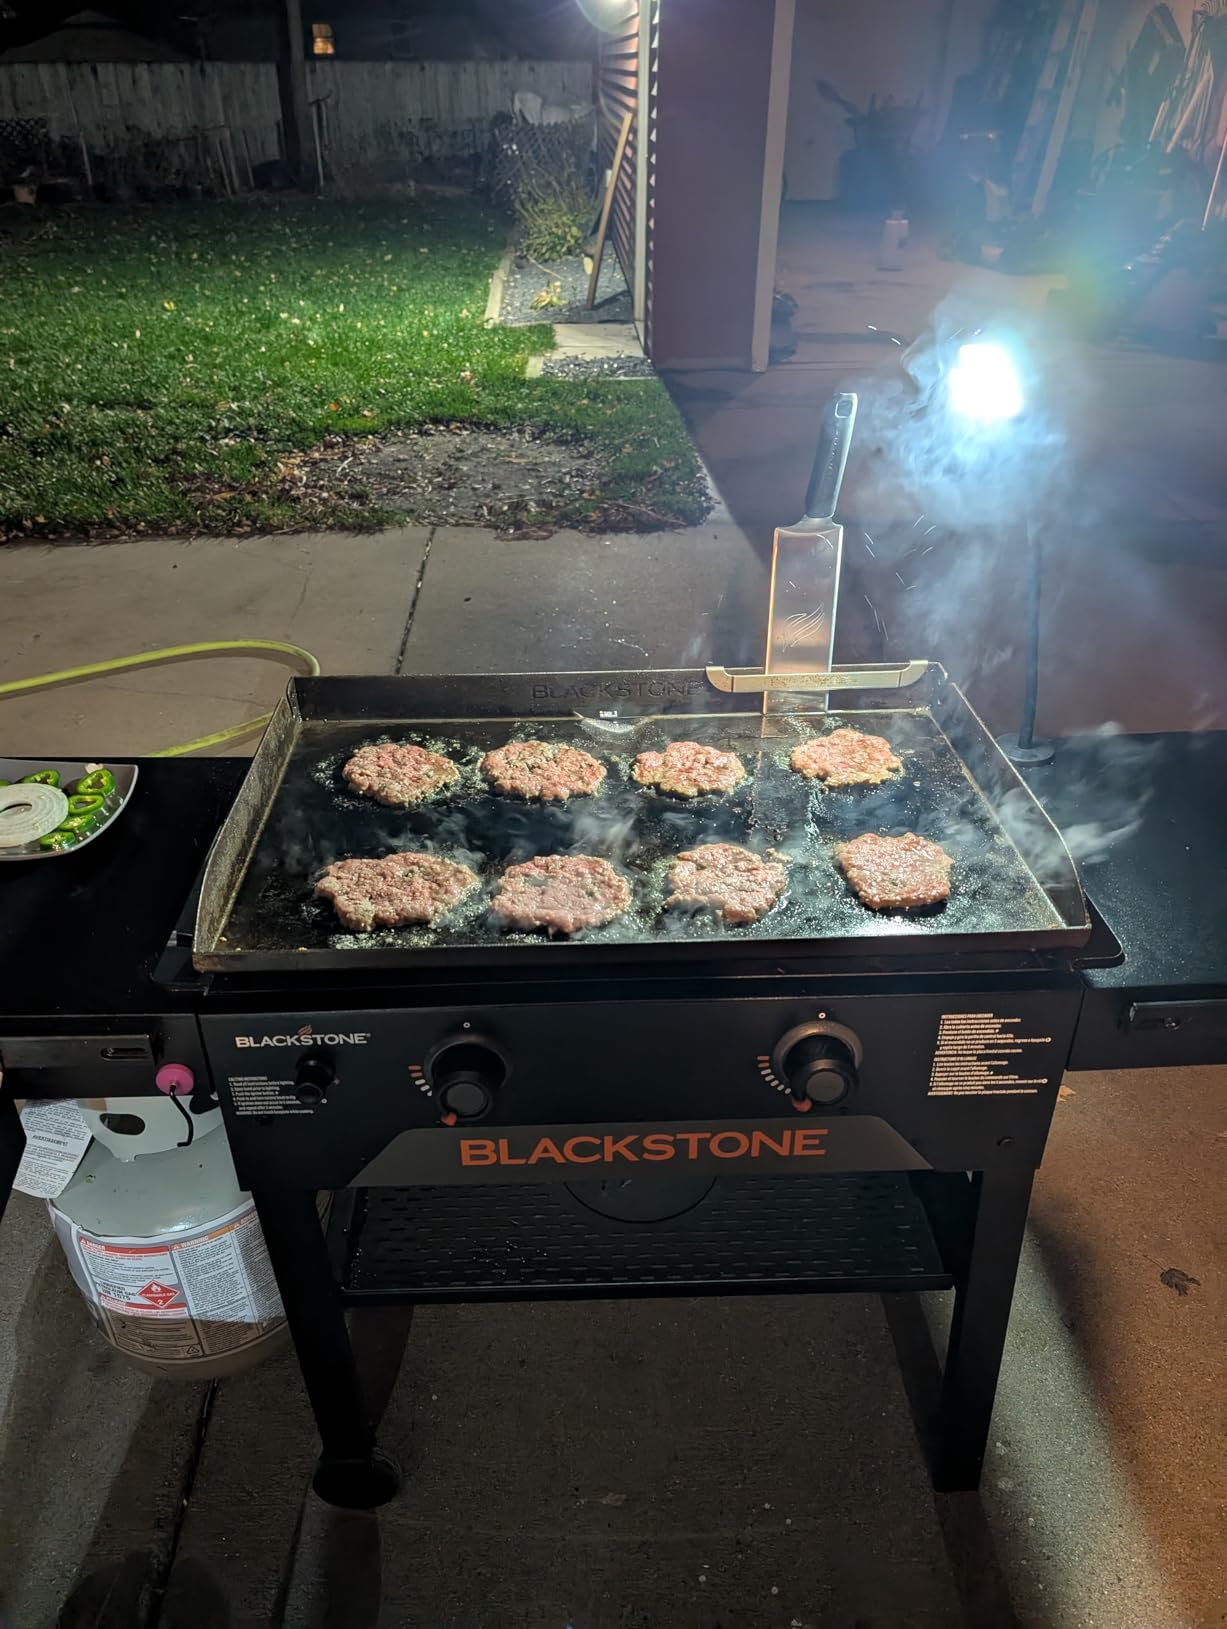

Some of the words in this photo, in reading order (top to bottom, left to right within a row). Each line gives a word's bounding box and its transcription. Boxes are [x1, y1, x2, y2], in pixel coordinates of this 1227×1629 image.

[532, 681, 704, 700] BLACKSTONE
[234, 1033, 368, 1049] BLACKSTONE
[459, 1128, 829, 1167] BLACKSTONE
[181, 1235, 209, 1248] WARNING
